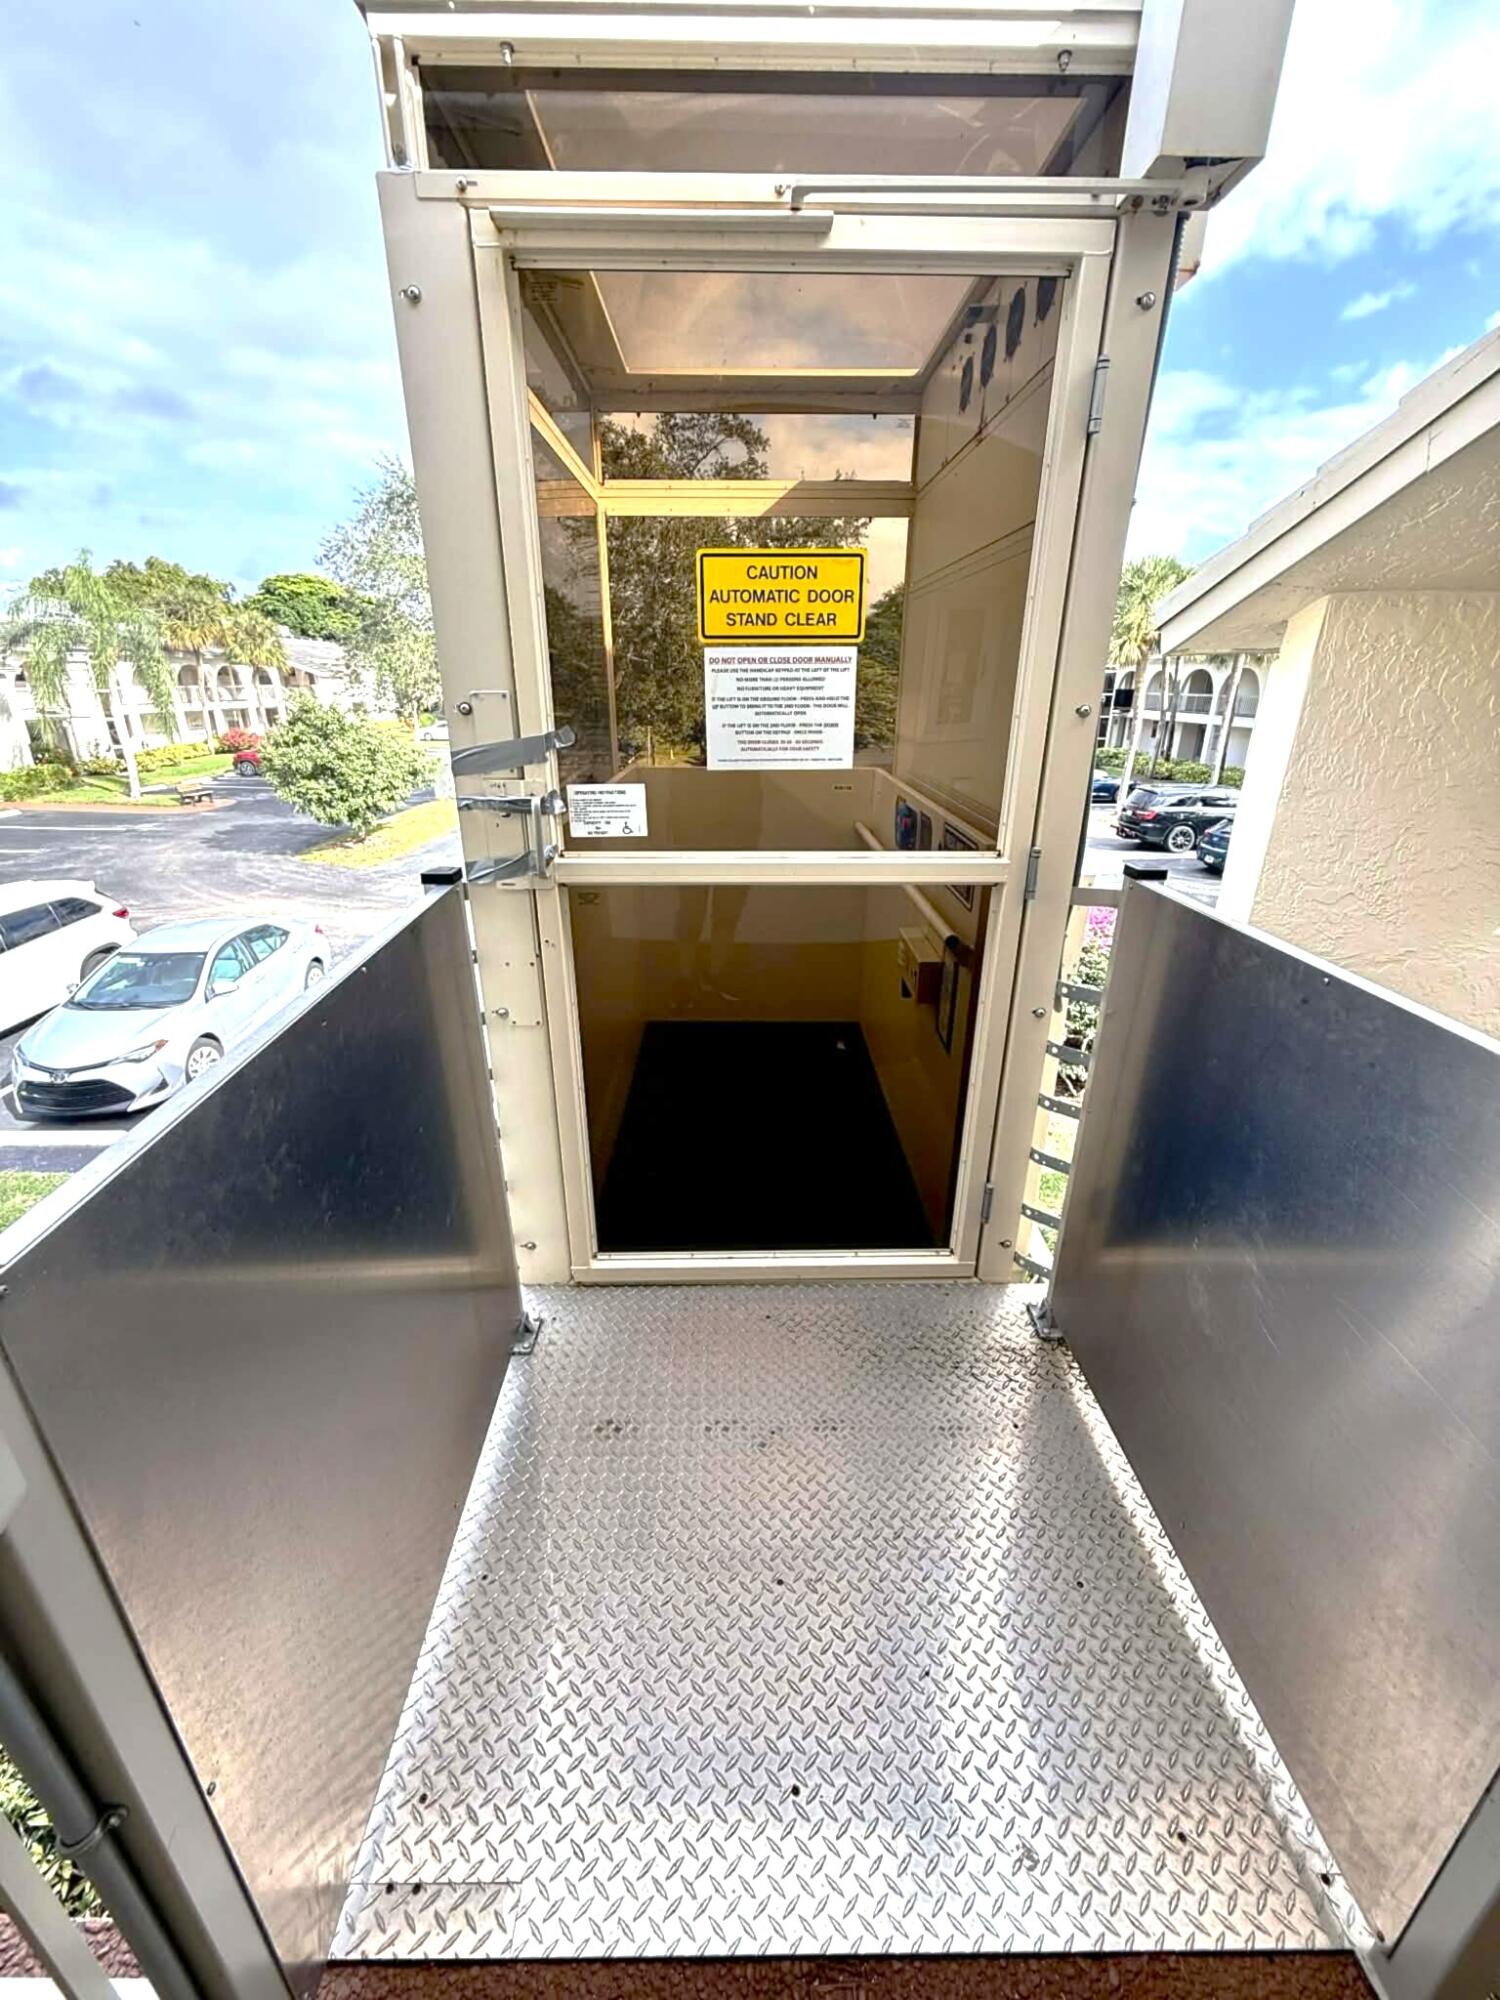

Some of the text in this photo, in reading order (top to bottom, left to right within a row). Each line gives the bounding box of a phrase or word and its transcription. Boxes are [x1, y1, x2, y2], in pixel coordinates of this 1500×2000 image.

[747, 565, 818, 580] CAUTION
[709, 589, 854, 604] AUTOMATIC DOOR
[726, 612, 836, 627] STAND CLEAR
[709, 656, 852, 665] DO NOT OPEN OR CLOSE DOOR MANUALLY
